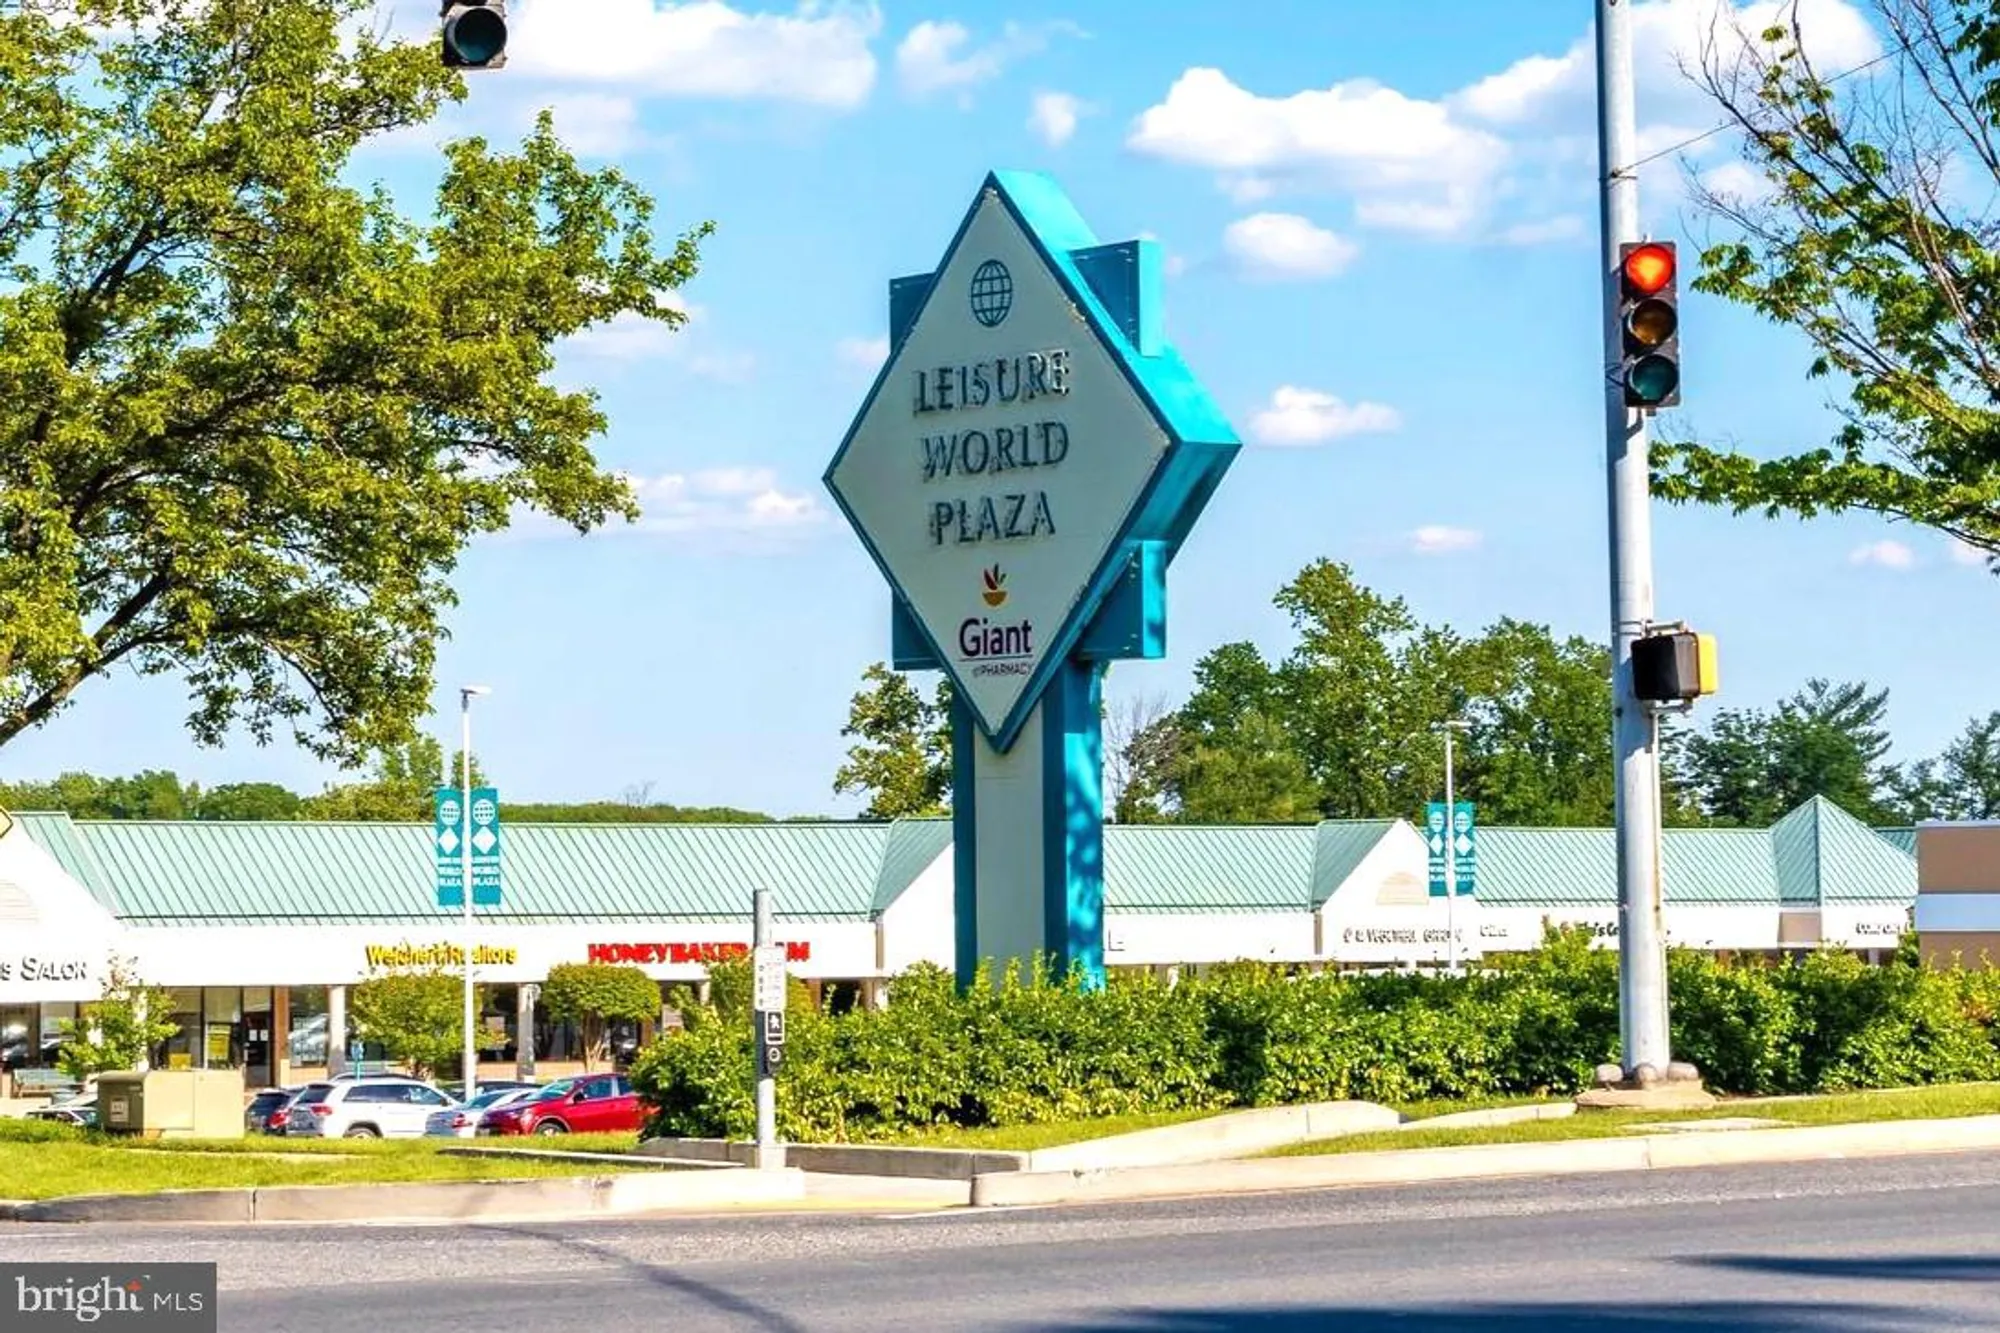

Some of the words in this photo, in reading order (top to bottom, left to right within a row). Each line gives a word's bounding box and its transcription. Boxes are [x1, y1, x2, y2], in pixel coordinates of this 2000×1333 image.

[913, 350, 1069, 416] LEISURE
[922, 421, 1069, 481] WORLD
[930, 490, 1056, 545] PLAZA
[959, 617, 1032, 657] Giant
[20, 956, 87, 981] SALON
